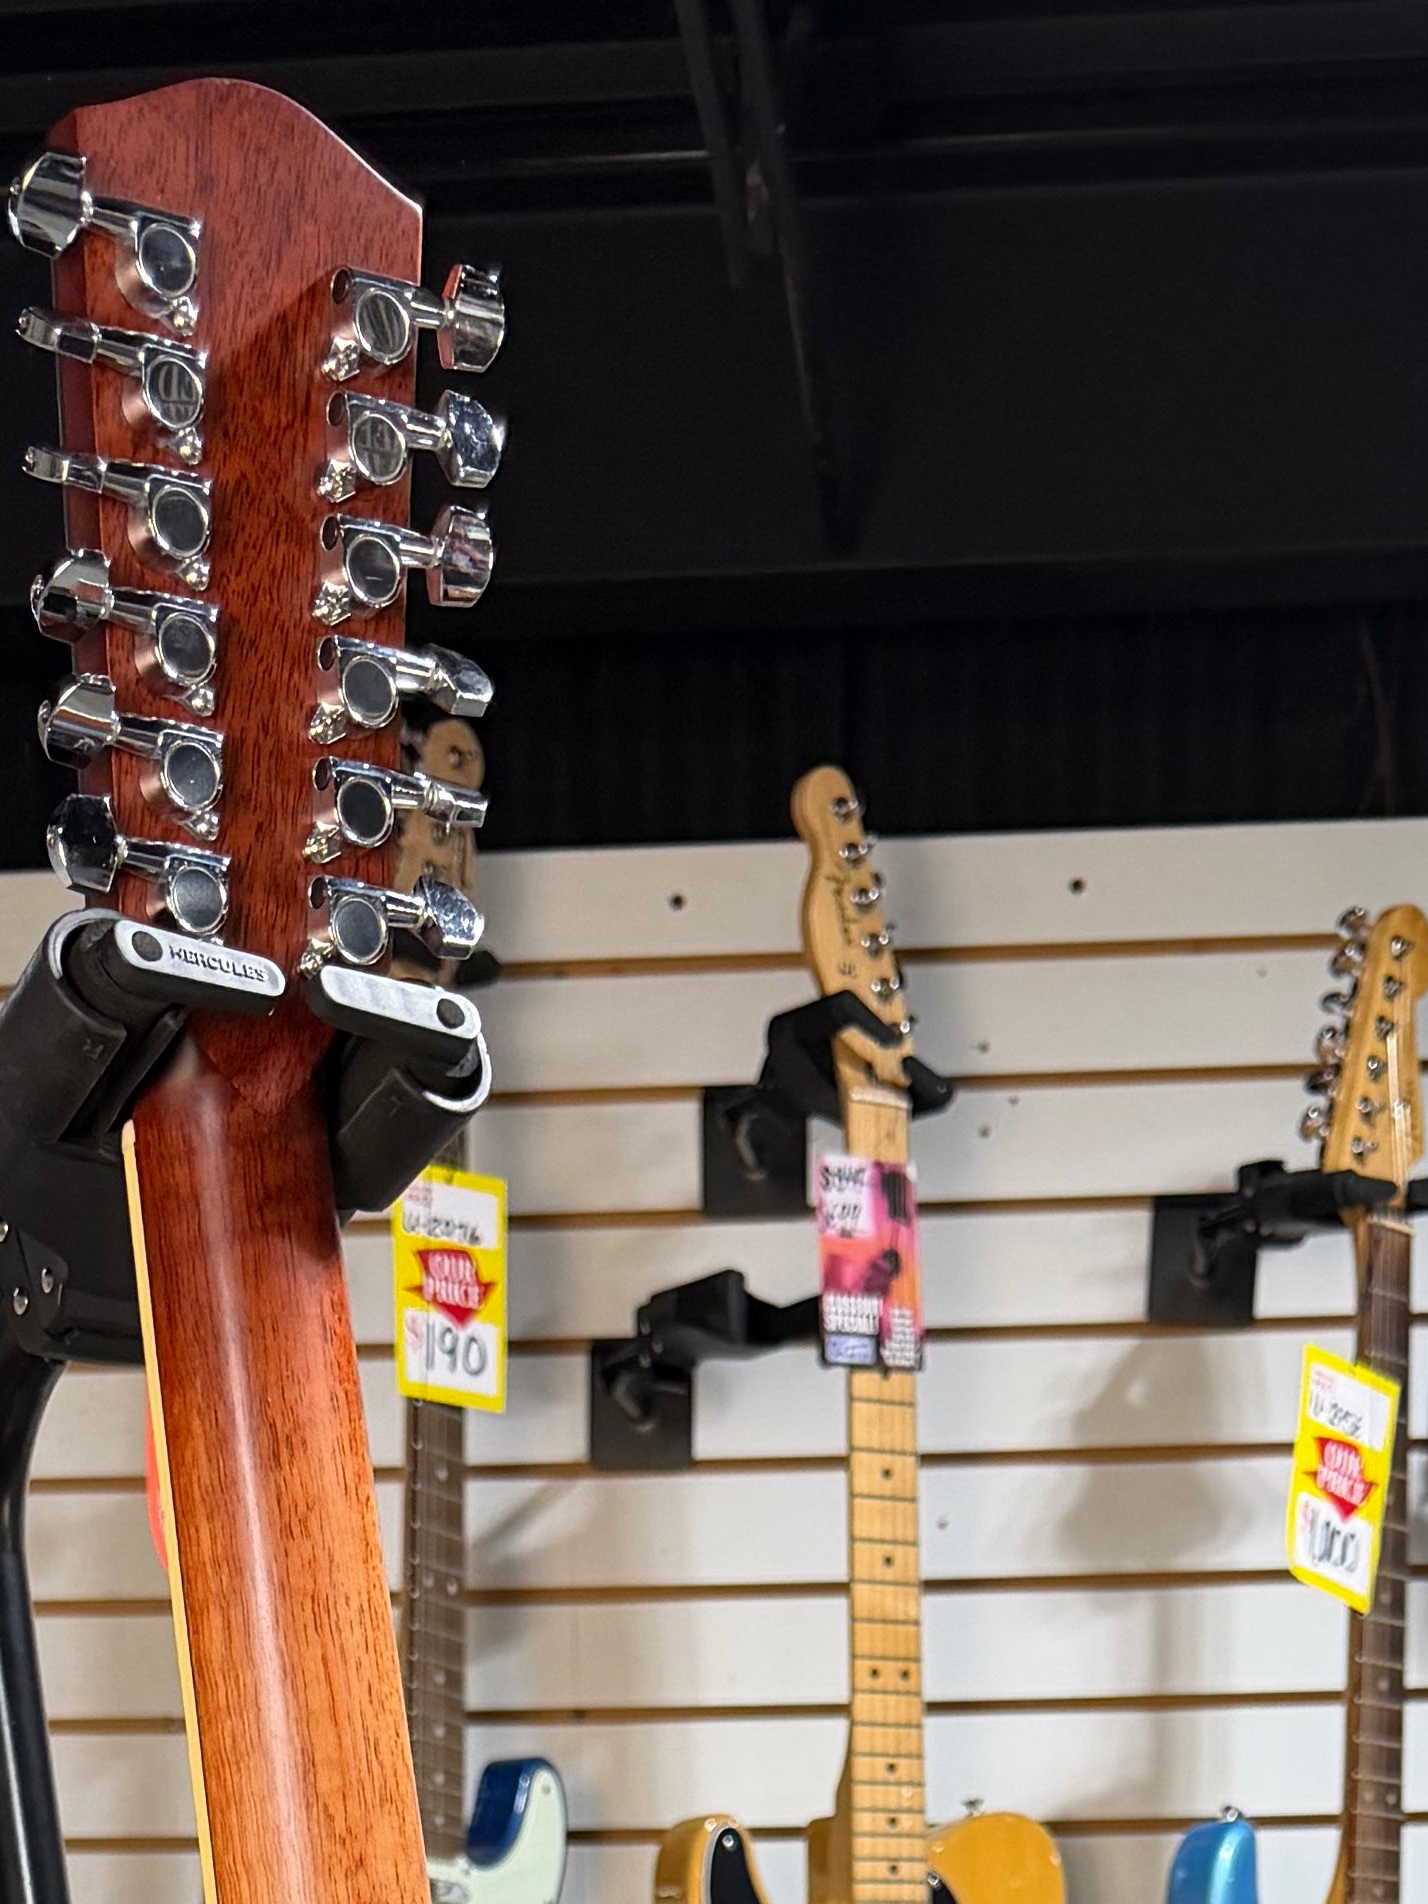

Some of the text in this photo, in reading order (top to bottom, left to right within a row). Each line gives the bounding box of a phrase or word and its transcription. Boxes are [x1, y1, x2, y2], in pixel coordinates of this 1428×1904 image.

[168, 944, 269, 984] HERCULES
[426, 1251, 477, 1285] OUR
[422, 1277, 483, 1311] PRICE
[1322, 1439, 1364, 1478] OUR
[1317, 1463, 1366, 1507] PRICE
